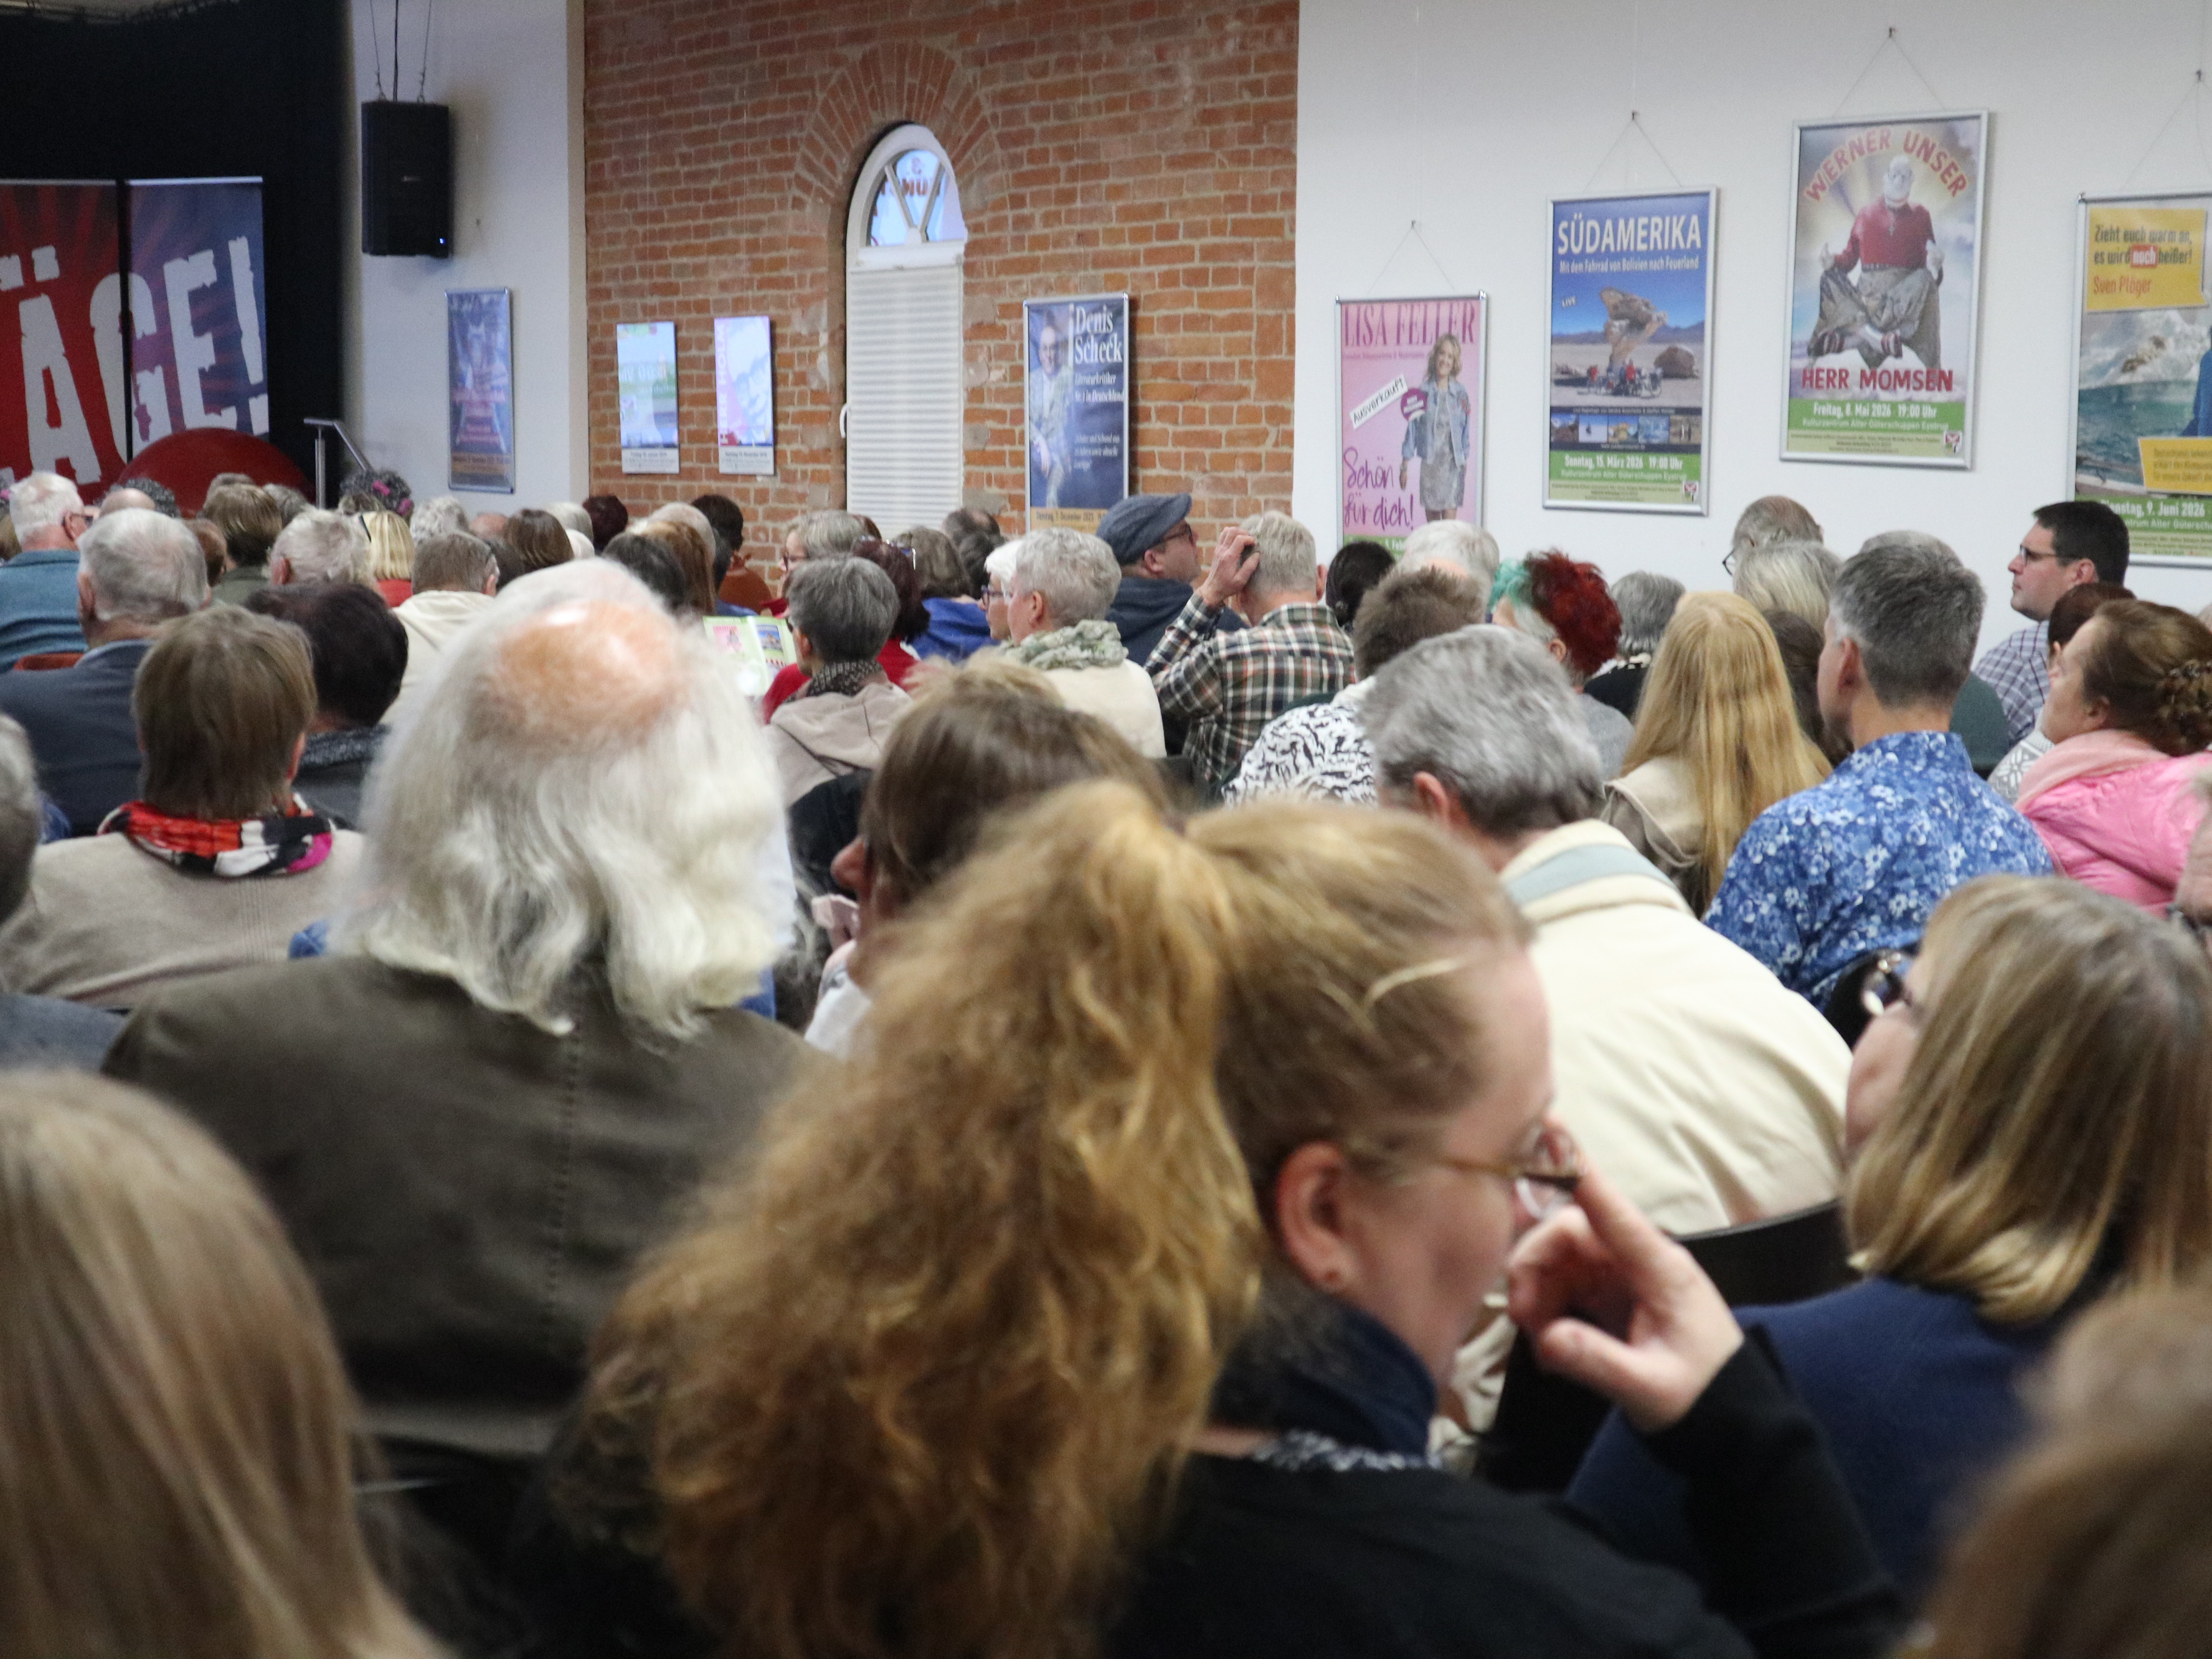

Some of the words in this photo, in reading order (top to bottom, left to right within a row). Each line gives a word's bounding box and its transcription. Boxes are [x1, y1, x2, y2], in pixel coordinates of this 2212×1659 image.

[1803, 126, 1892, 203] WERNER
[1902, 130, 1969, 198] UNSER
[1557, 212, 1701, 255] SÜDAMERIKA
[2094, 225, 2120, 243] Zieht
[2123, 225, 2146, 243] euch
[2149, 229, 2177, 243] warm
[2094, 250, 2105, 264] es
[2107, 247, 2130, 264] wird
[2132, 245, 2157, 265] noch
[1075, 304, 1113, 335] Denis
[1345, 305, 1387, 347] LISA
[1396, 303, 1475, 346] FELLER
[0, 235, 269, 484] ÄGE!
[1074, 332, 1123, 365] Scheck
[1802, 367, 1850, 390] HERR
[1860, 368, 1954, 392] MOMSEN
[1813, 402, 1844, 419] Freitag,
[1855, 404, 1870, 417] Mai
[1871, 404, 1891, 417] 2026
[1898, 405, 1921, 418] 19:00
[1922, 405, 1937, 418] Uhr
[1343, 447, 1394, 489] Schön
[1564, 454, 1595, 470] Sonntag,
[1607, 455, 1625, 468] März
[1626, 456, 1643, 468] 2026
[1670, 456, 1683, 470] Uhr
[1343, 493, 1371, 527] für
[1373, 494, 1414, 531] dich!
[2158, 501, 2179, 516] Juni
[2181, 501, 2205, 517] 2026
